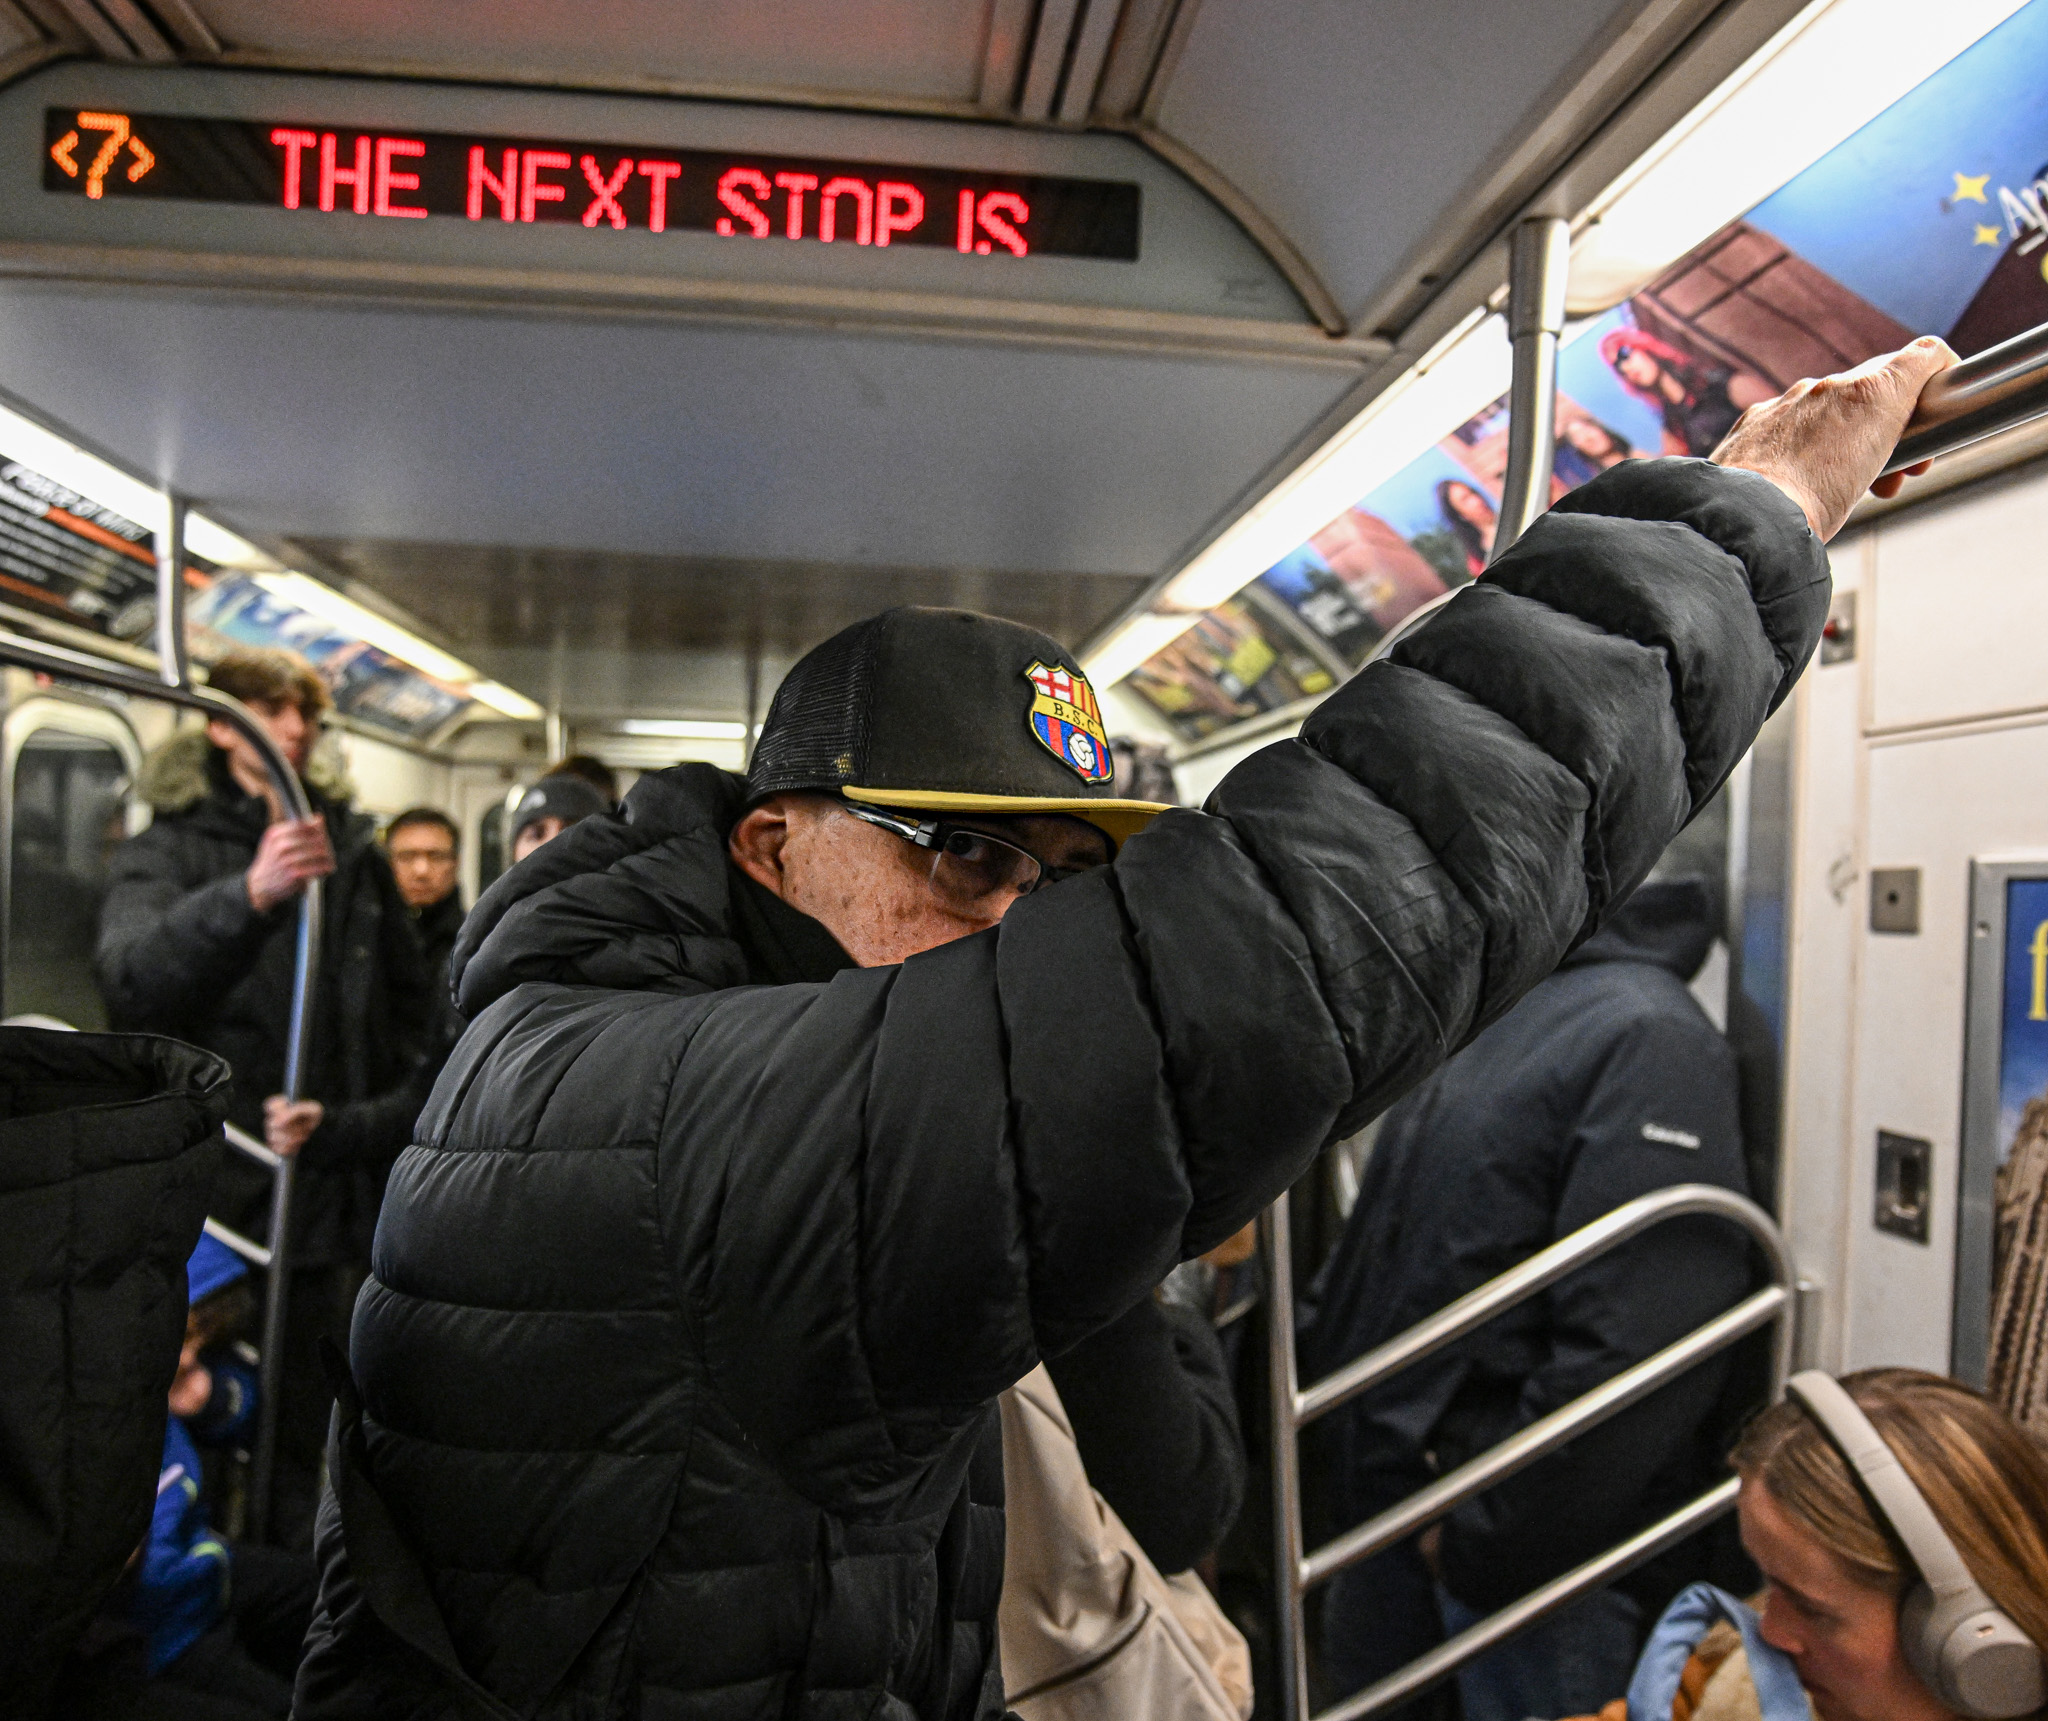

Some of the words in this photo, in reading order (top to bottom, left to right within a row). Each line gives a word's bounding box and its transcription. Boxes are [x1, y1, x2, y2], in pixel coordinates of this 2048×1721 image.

[271, 128, 428, 219] THE
[716, 167, 925, 248] STOP
[957, 189, 1030, 258] IS
